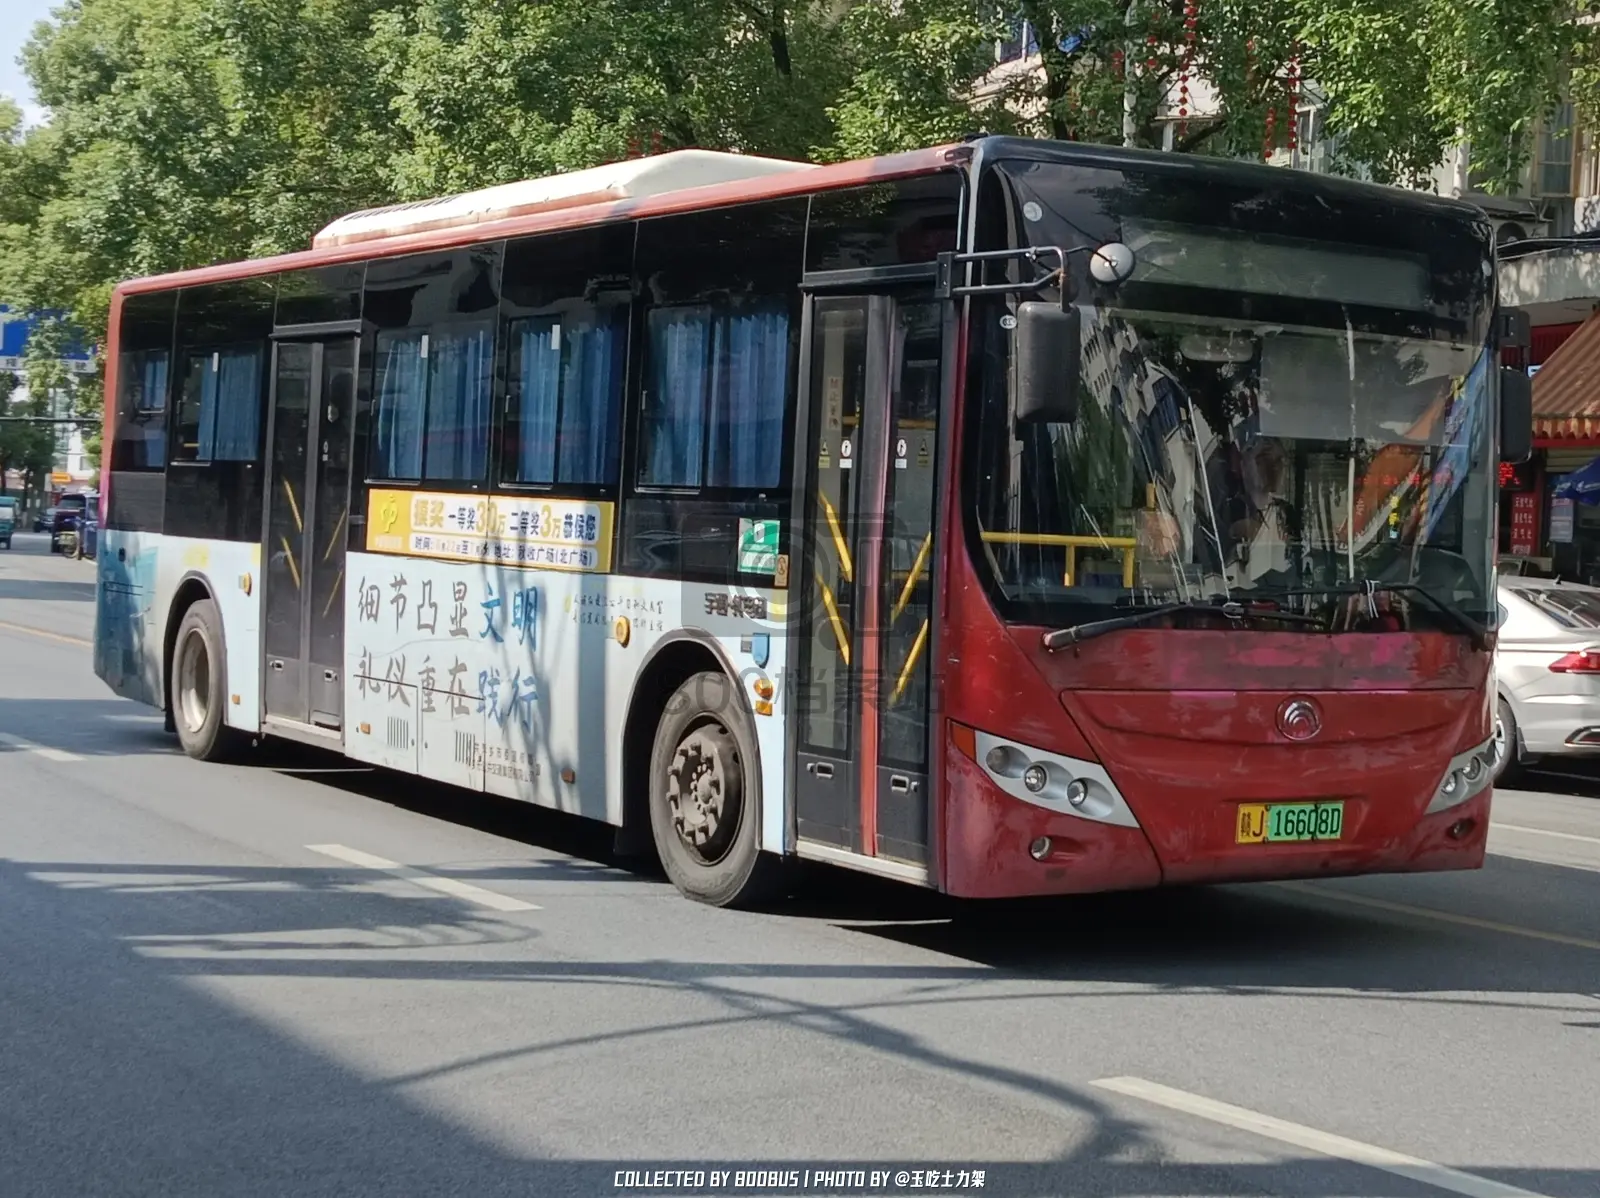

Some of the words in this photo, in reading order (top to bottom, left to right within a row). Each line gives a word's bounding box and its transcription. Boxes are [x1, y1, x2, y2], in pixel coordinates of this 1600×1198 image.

[358, 573, 538, 652] 细节凸显文明
[357, 645, 540, 734] 礼仪重在践行
